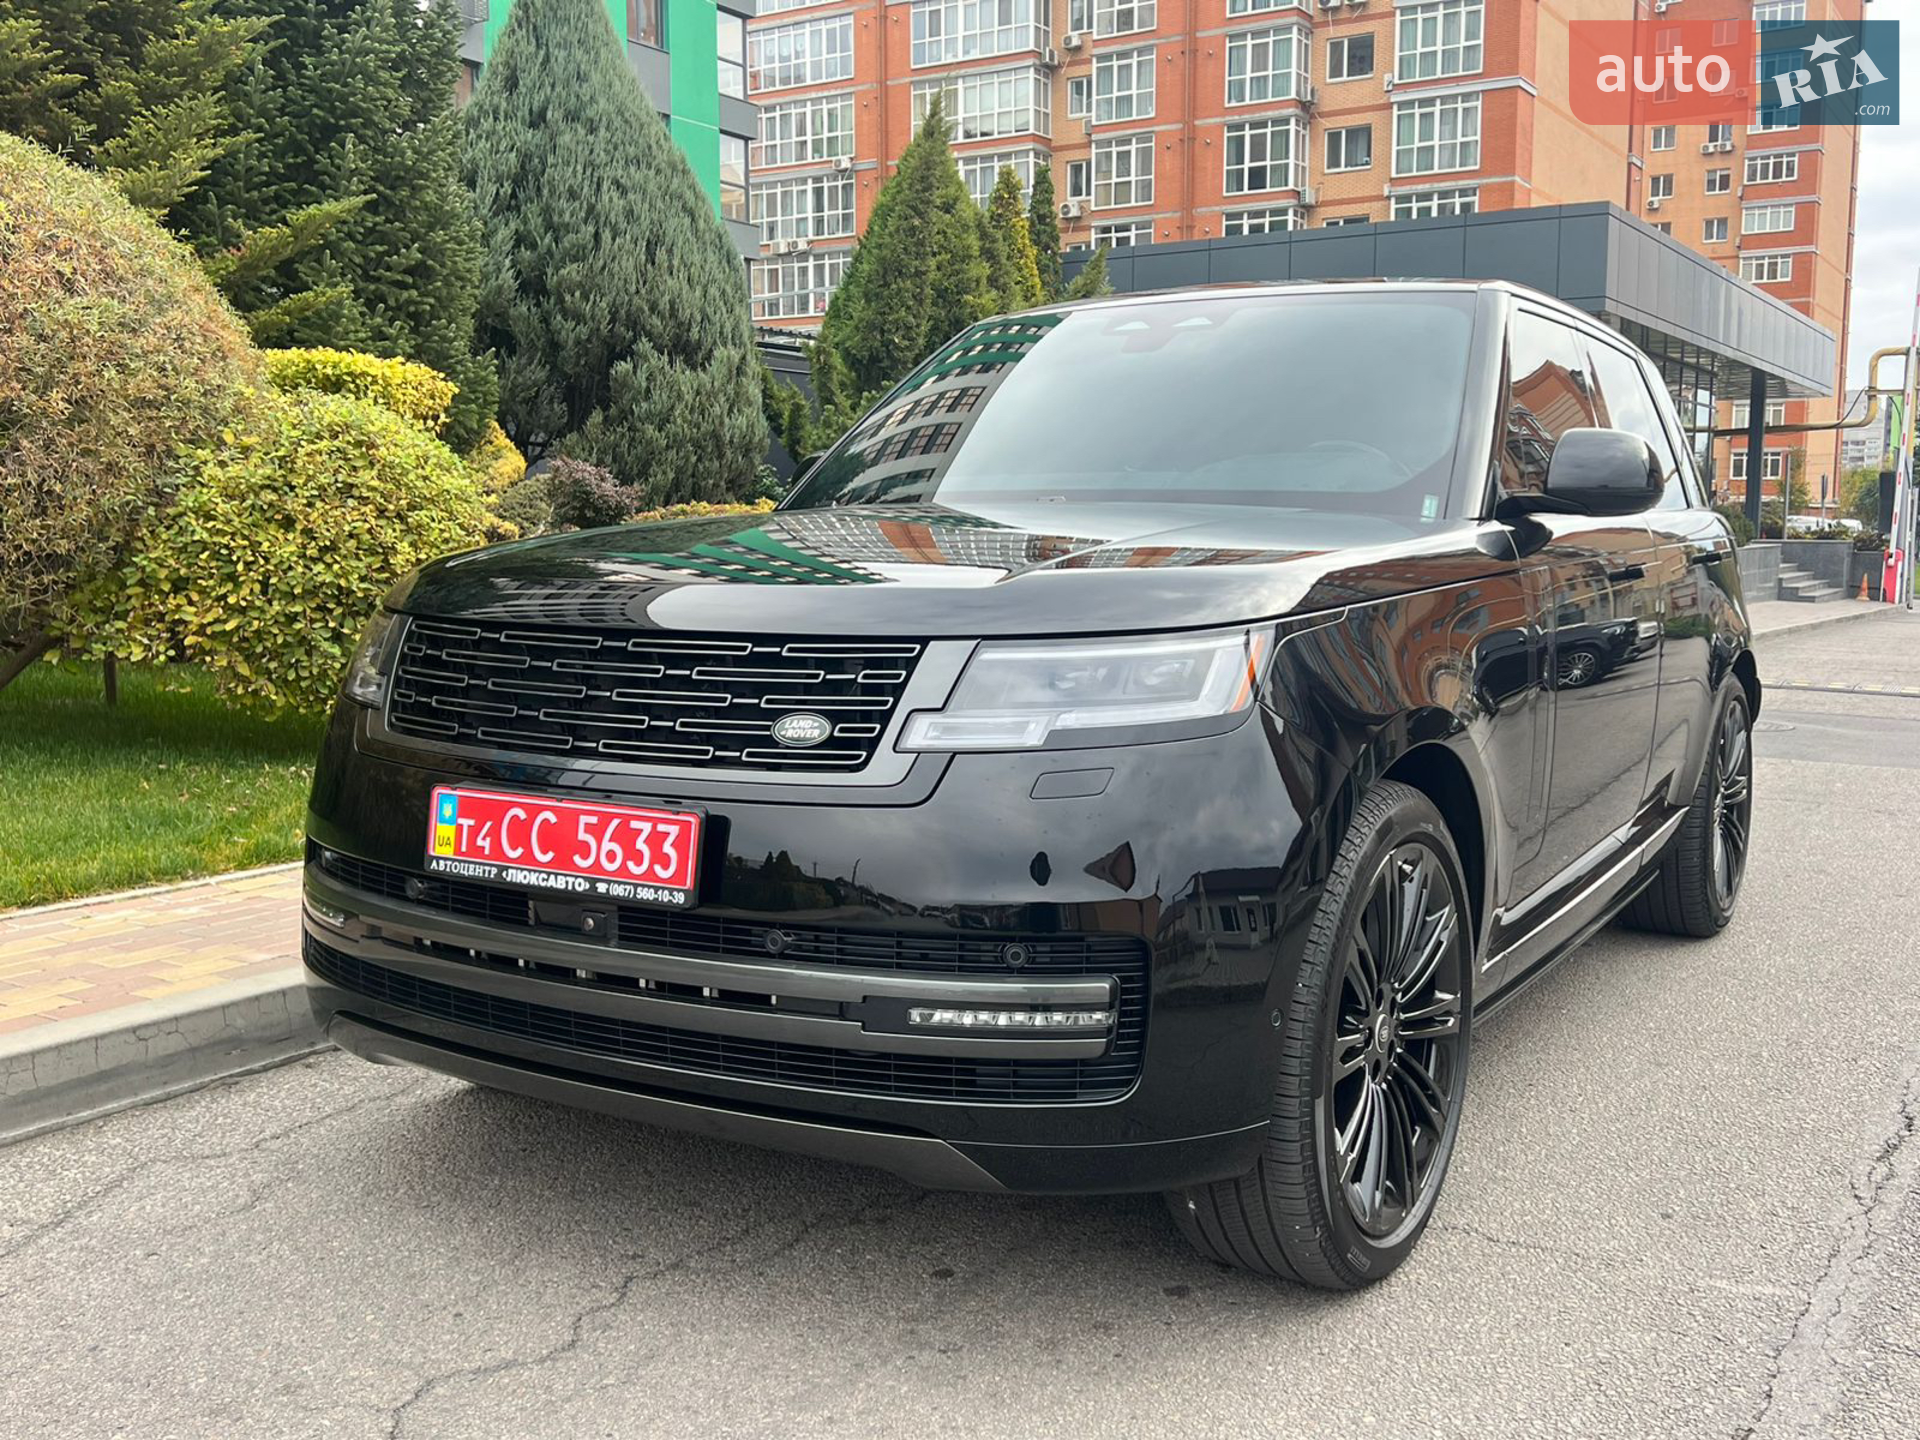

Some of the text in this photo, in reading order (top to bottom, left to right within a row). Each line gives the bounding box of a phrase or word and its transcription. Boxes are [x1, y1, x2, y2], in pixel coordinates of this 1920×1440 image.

[784, 719, 812, 729] LAND
[785, 728, 821, 738] ROVER
[437, 835, 452, 849] UA
[572, 814, 680, 880] 5633
[430, 858, 498, 880] АВТОЦЕНТР
[609, 883, 635, 900] (067)
[636, 885, 685, 905] 560-10-39
